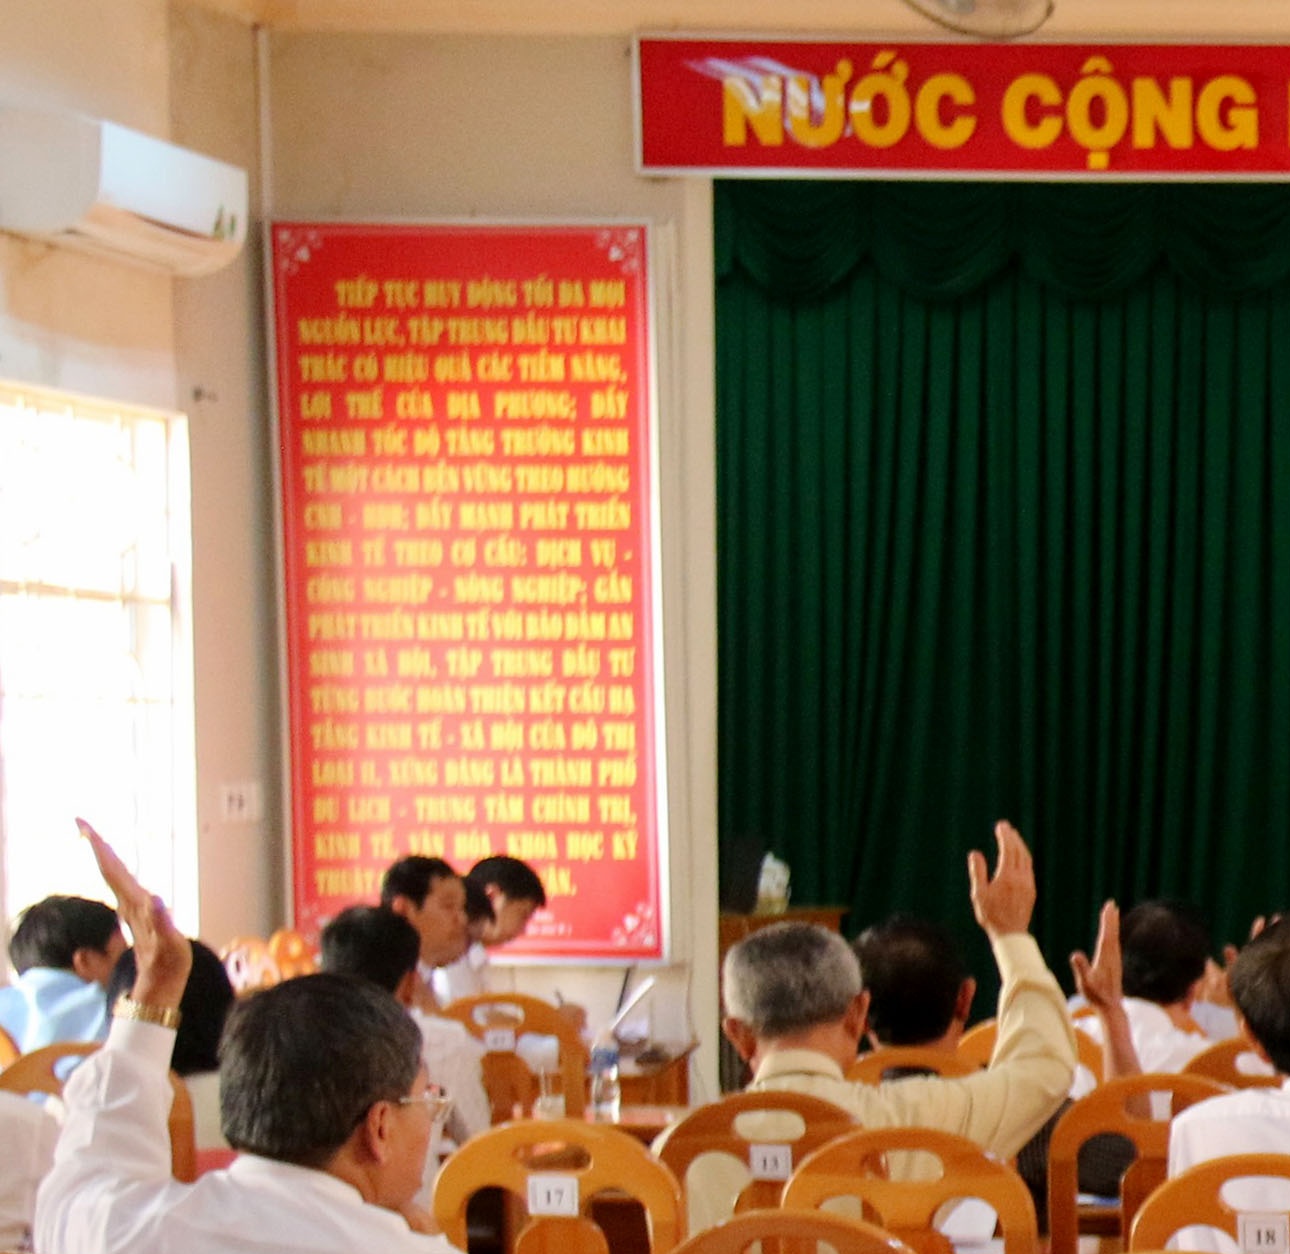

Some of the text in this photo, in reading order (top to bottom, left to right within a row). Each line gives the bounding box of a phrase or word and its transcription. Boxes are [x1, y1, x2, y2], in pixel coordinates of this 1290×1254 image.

[721, 51, 977, 149] NƯỚC
[1002, 58, 1259, 170] CỘNG
[546, 1188, 564, 1206] 17
[1256, 1227, 1276, 1246] 18
